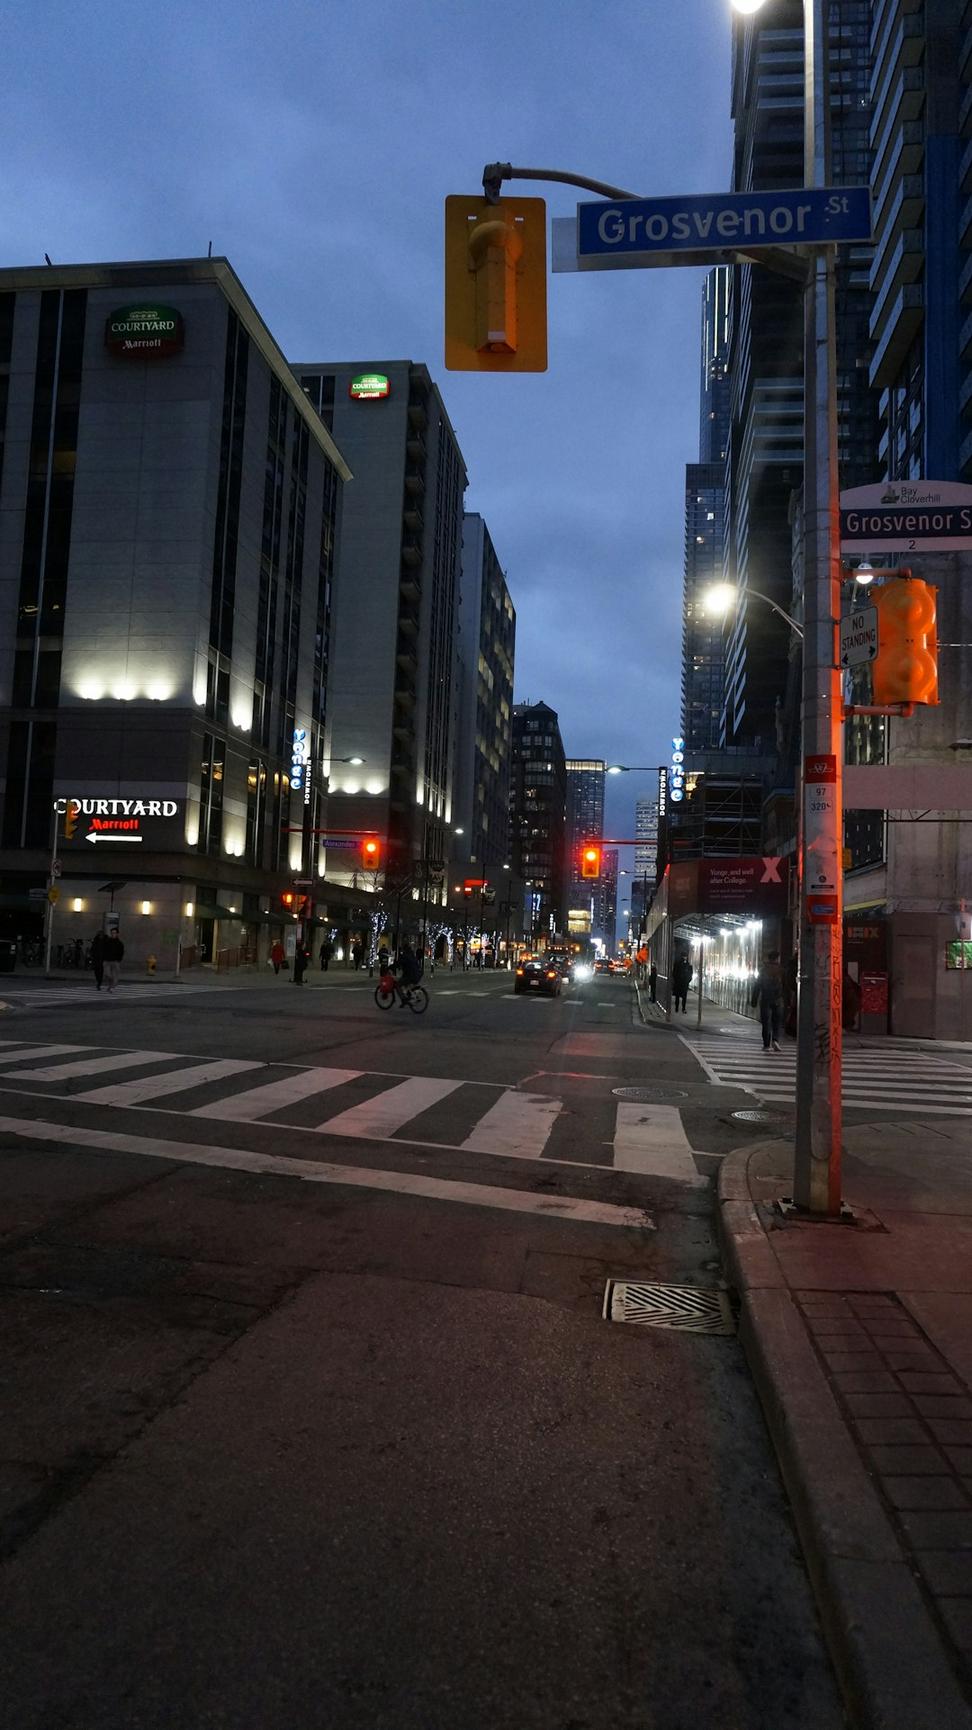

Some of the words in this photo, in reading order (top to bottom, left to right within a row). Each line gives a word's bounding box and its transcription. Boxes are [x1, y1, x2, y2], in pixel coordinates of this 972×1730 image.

[597, 204, 811, 244] Grosvenor
[828, 196, 849, 215] St
[111, 320, 175, 332] COURTYARD
[122, 337, 161, 350] Marriott
[901, 486, 918, 497] Bay
[900, 493, 941, 504] Cloverhill
[846, 512, 953, 533] Grosvenor
[908, 540, 916, 550] 2
[852, 615, 864, 631] NO
[842, 628, 876, 651] STANDING
[304, 759, 312, 805] DOWNTOWN
[816, 787, 826, 796] 97
[53, 798, 178, 817] COURTYARD
[88, 818, 140, 831] Marriott
[730, 868, 741, 876] and
[760, 857, 783, 883] X
